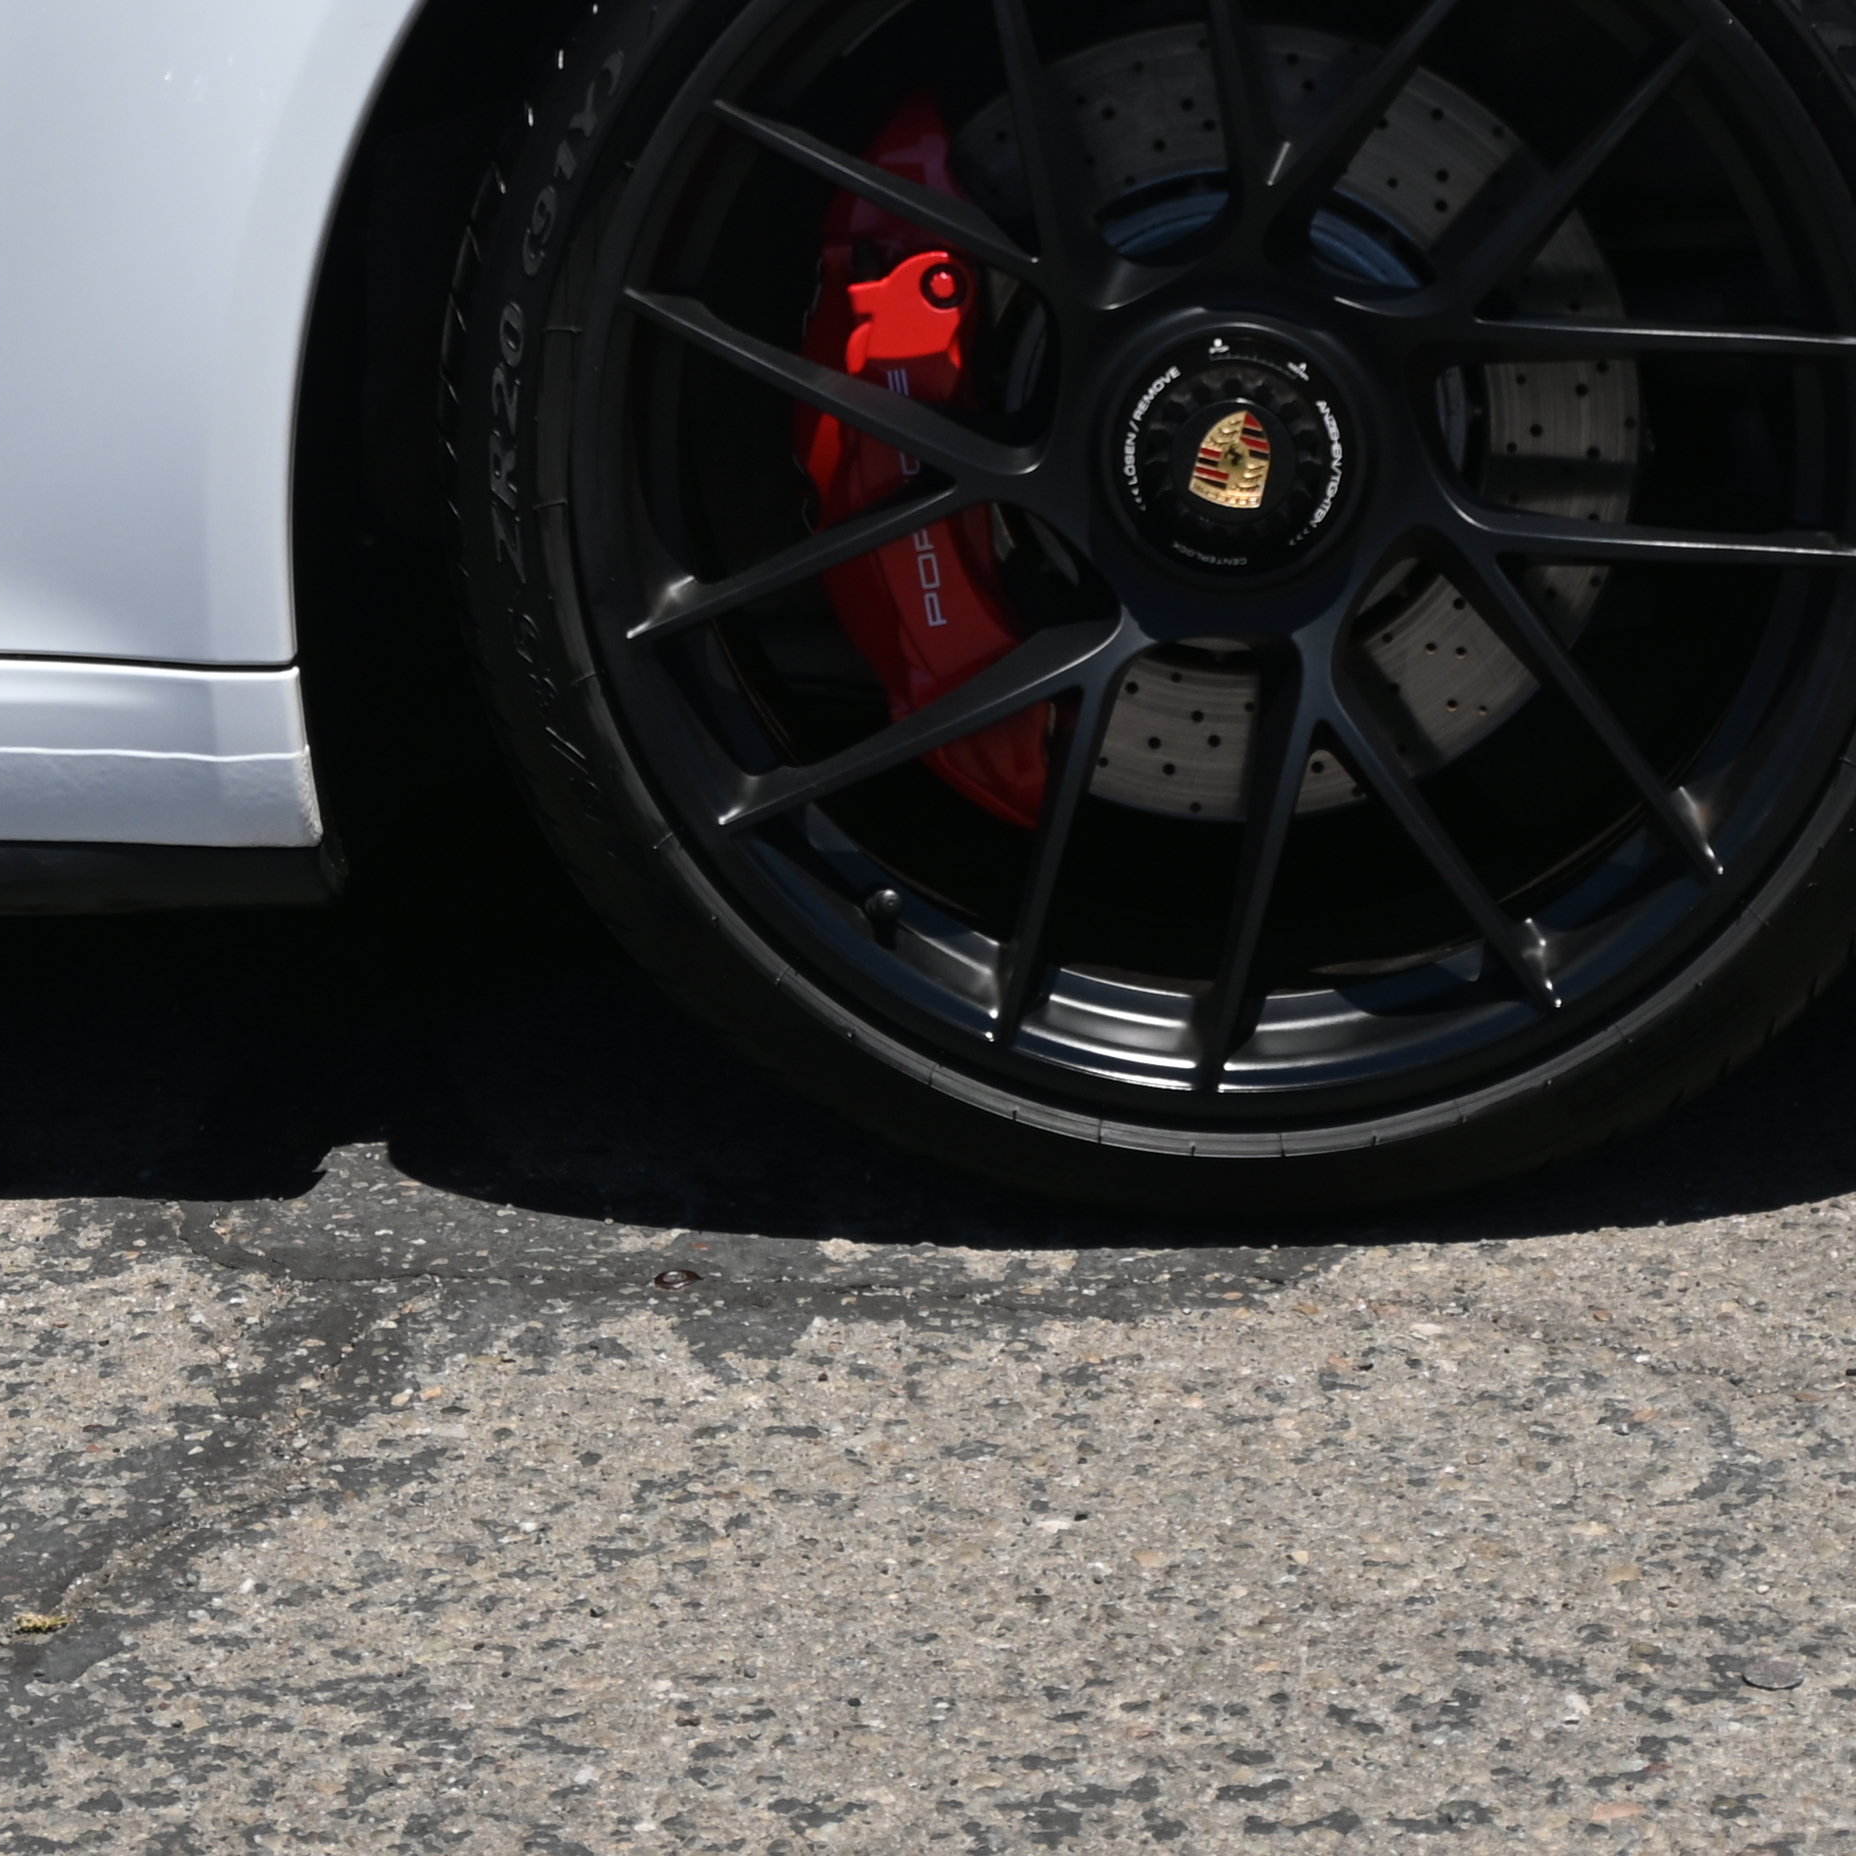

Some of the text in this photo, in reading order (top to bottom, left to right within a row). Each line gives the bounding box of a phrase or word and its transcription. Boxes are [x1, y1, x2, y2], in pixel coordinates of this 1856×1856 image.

[523, 50, 624, 276] (91Y)
[488, 300, 526, 585] ZR20
[887, 368, 947, 627] PORCE
[1131, 366, 1182, 422] REMOVE
[1173, 540, 1248, 566] CENTERLOCK
